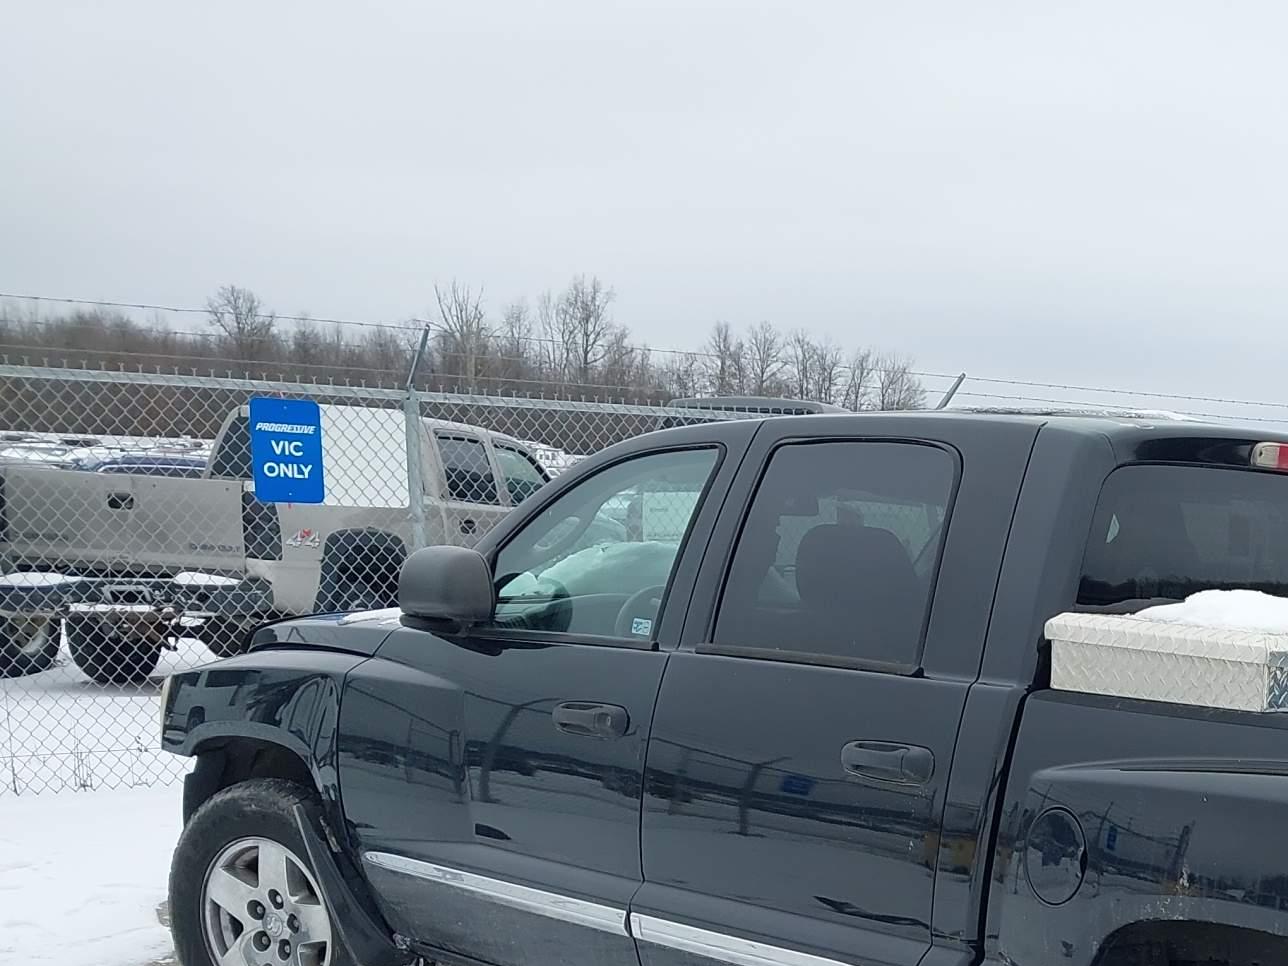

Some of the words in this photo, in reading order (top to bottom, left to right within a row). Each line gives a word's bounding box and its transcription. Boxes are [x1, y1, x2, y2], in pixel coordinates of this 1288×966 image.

[255, 422, 317, 435] PROGRESSIVE
[270, 440, 304, 457] VIC
[263, 461, 313, 479] ONLY
